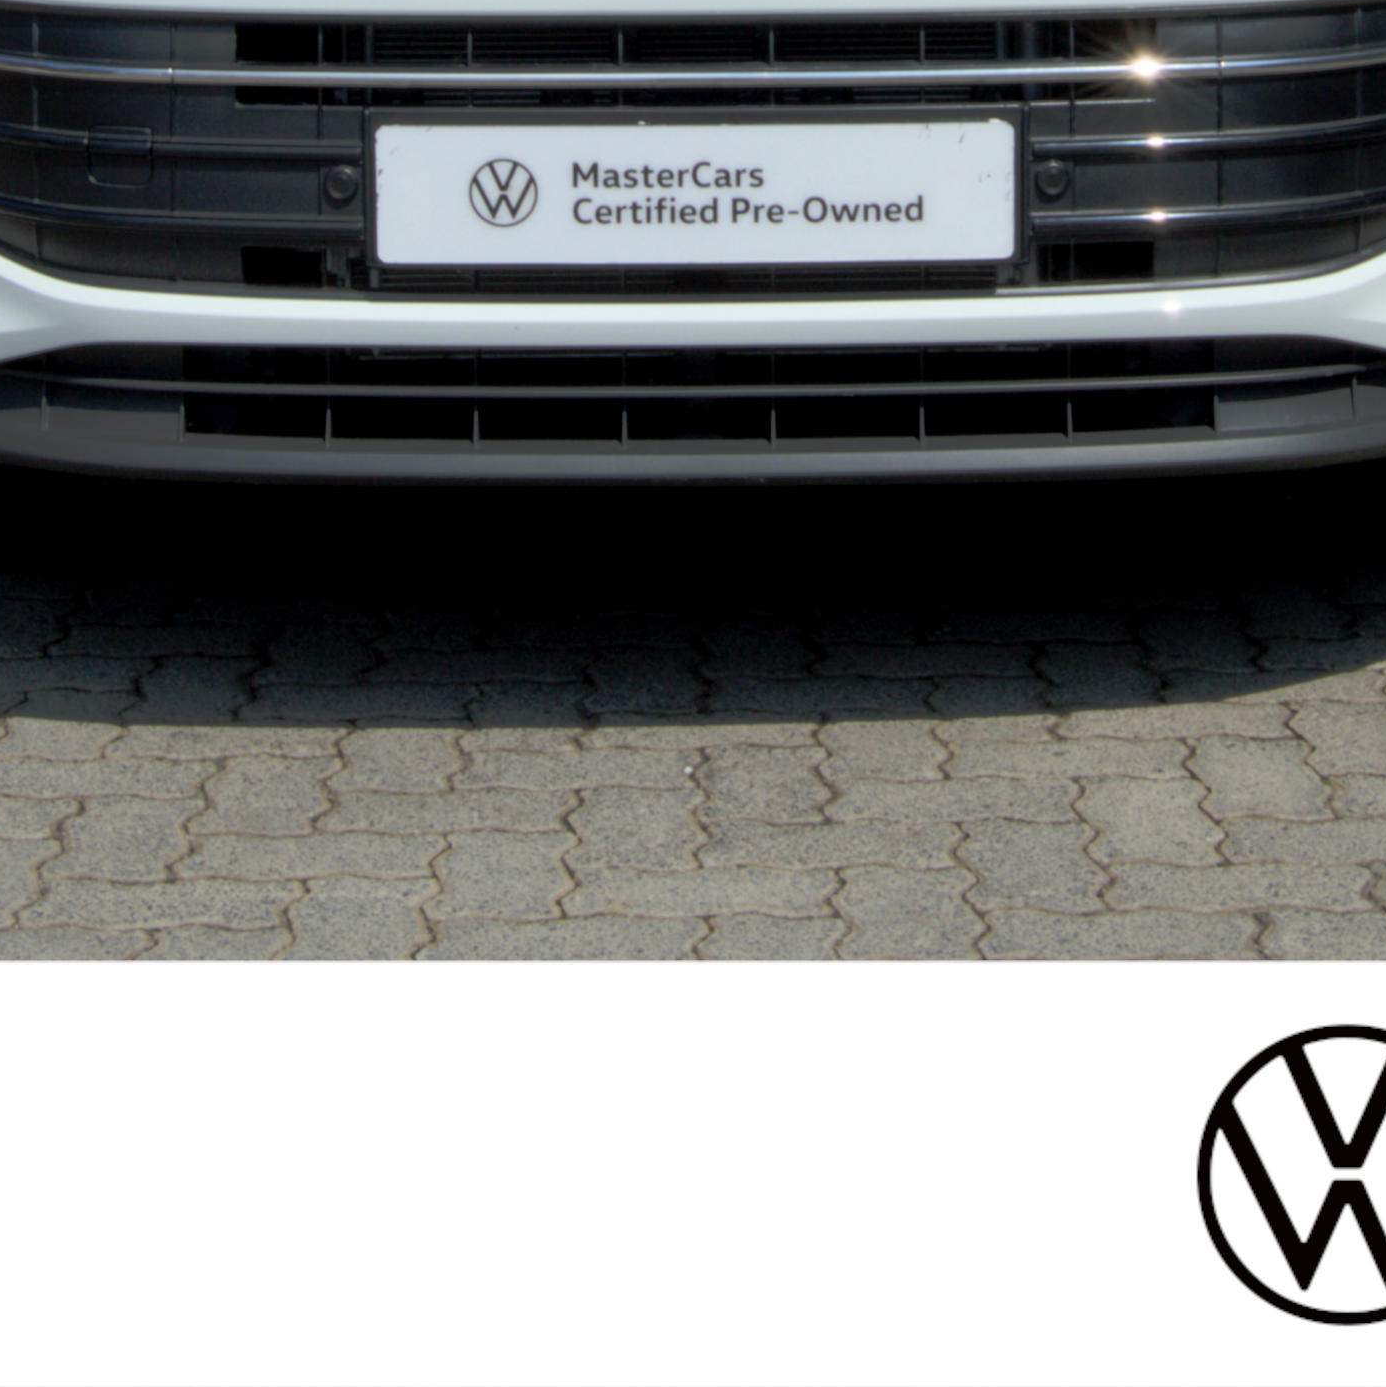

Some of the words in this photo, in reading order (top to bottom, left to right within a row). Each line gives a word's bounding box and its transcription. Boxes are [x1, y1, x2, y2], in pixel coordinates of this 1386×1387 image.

[571, 160, 765, 189] MasterCars
[572, 196, 720, 225] Certified
[731, 194, 925, 225] Pre-Owned
